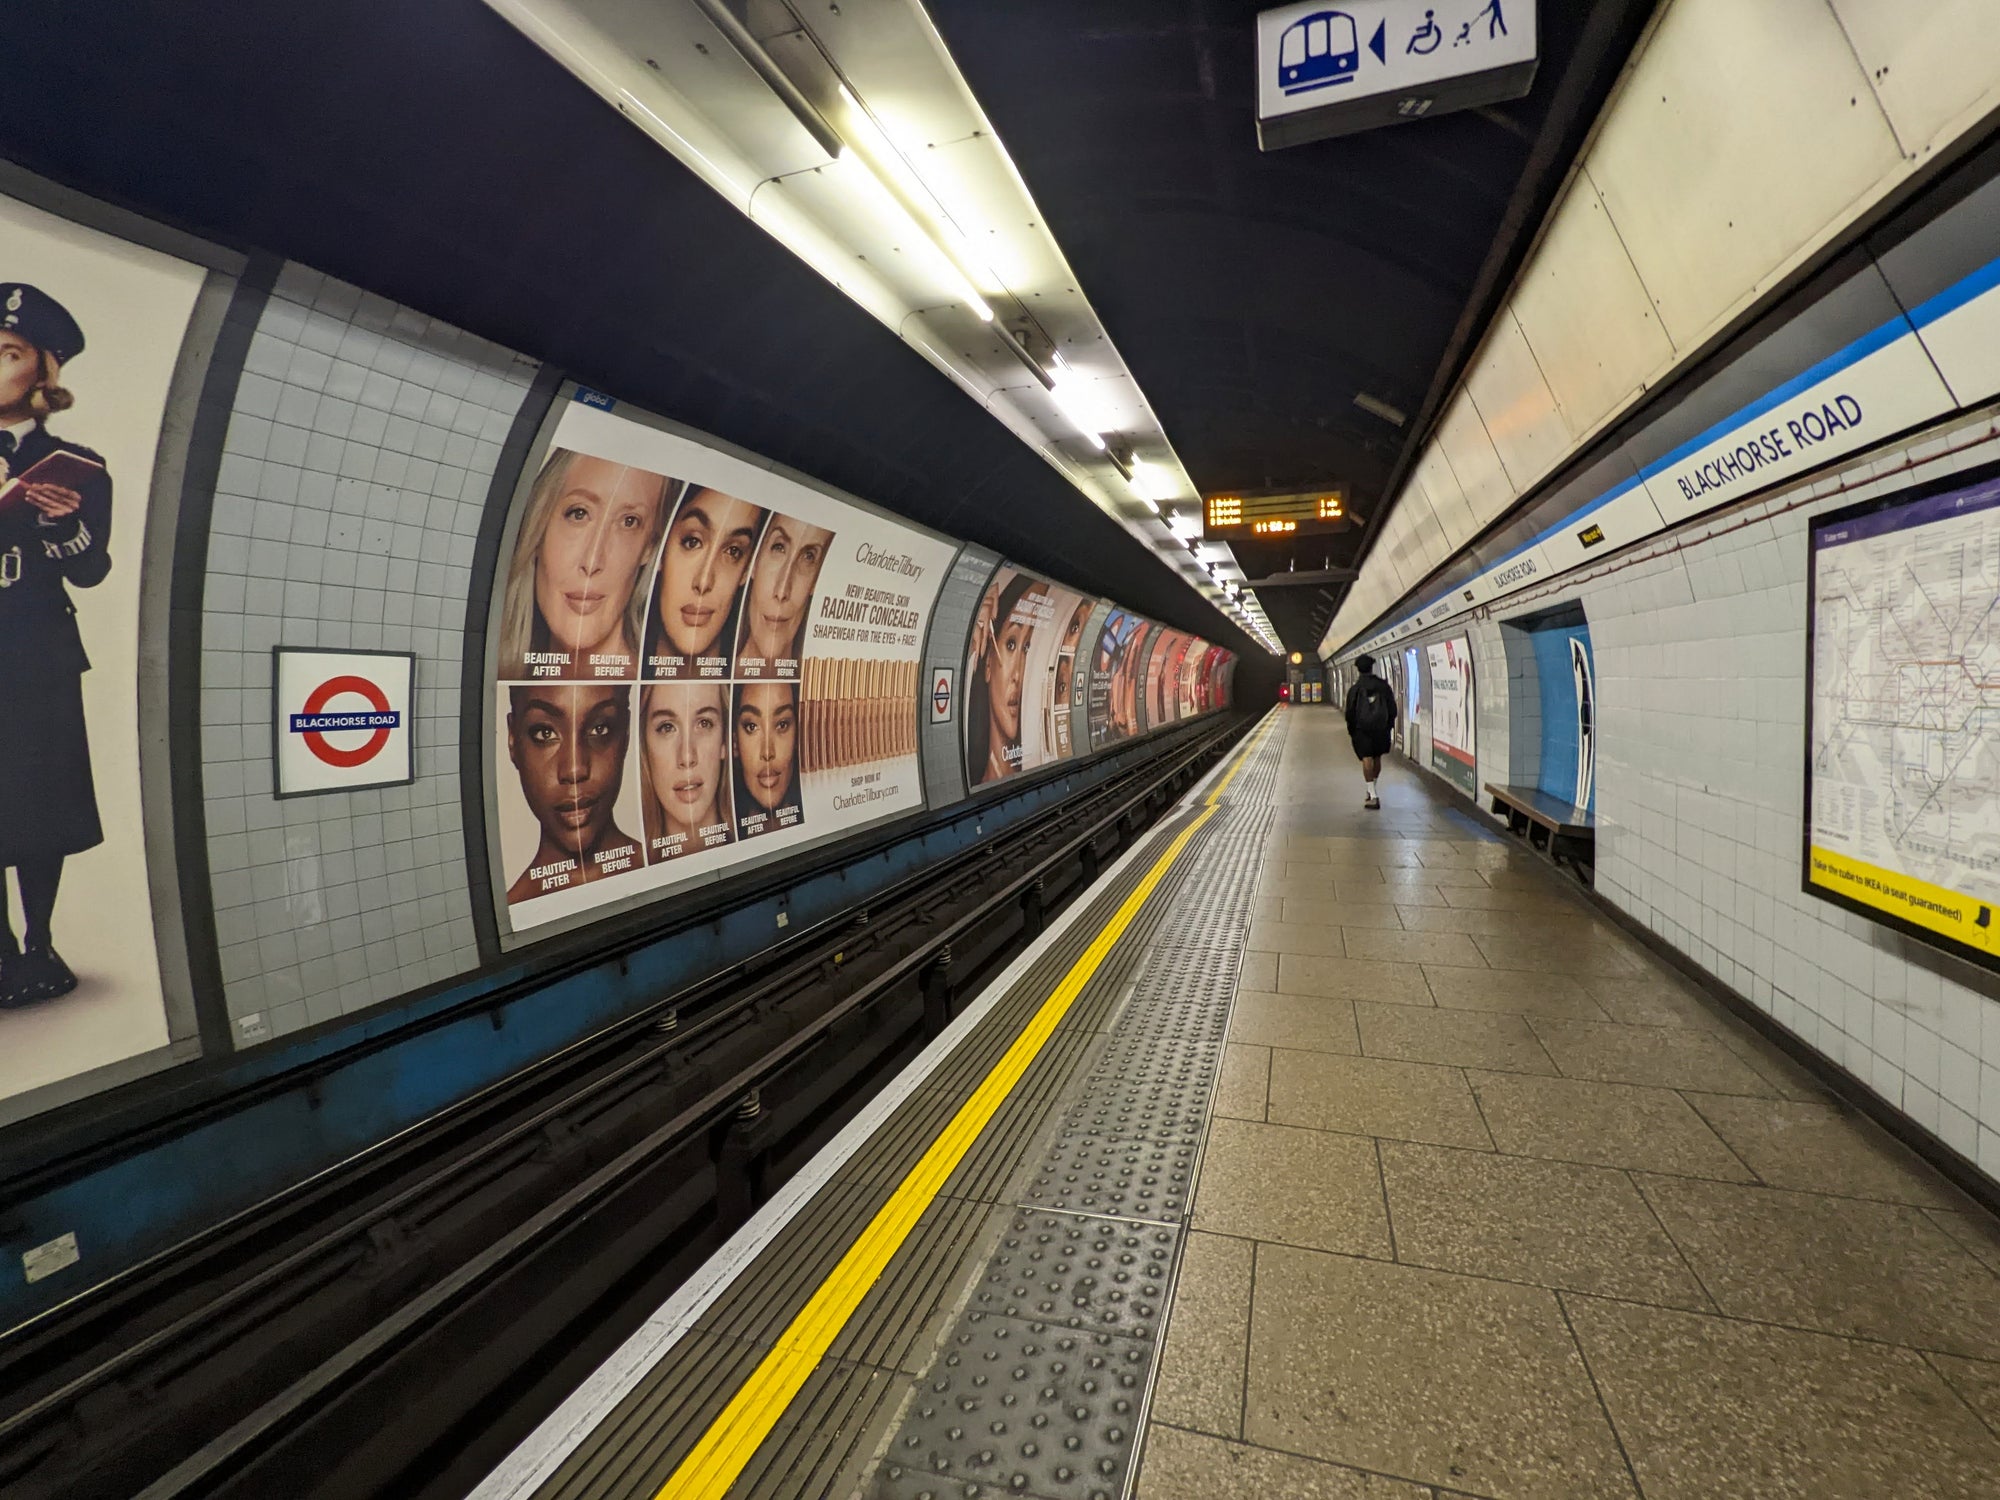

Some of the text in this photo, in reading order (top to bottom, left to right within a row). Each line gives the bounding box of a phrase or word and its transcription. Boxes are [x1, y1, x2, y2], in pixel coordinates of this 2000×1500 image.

[1677, 394, 1862, 501] BLACKHORSE ROAD
[845, 583, 910, 608] NEW! BEAUTIFUL SKIN
[821, 596, 919, 630] RADIANT CONCEALER
[813, 624, 856, 641] SHAPEWEAR
[856, 628, 869, 643] FOR
[870, 630, 881, 643] THE
[882, 631, 896, 645] EYES
[524, 652, 571, 665] BEAUTIFUL
[589, 654, 631, 665] BEAUTIFUL
[649, 656, 684, 666] BEAUTIFUL
[696, 657, 728, 666] BEAUTIFUL
[739, 658, 766, 667] BEAUTIFUL
[774, 659, 798, 668] BEAUTIFUL
[533, 666, 561, 676] AFTER
[594, 667, 625, 676] BEFORE
[655, 667, 677, 676] AFTER
[700, 667, 723, 676] BEFORE
[744, 668, 760, 676] AFTER
[777, 668, 794, 677] BEFORE
[295, 716, 396, 728] BLACKHORSE ROAD
[775, 805, 800, 818] BEAUTIFUL
[741, 812, 768, 827] BEAUTIFUL
[780, 814, 798, 826] BEFORE
[699, 822, 730, 837] BEAUTIFUL
[747, 823, 764, 835] AFTER
[652, 831, 688, 849] BEAUTIFUL
[704, 832, 727, 846] BEFORE
[594, 844, 635, 864] BEAUTIFUL
[661, 844, 683, 858] AFTER
[530, 859, 577, 880] BEAUTIFUL
[601, 857, 631, 874] BEFORE
[542, 873, 570, 891] AFTER
[1813, 858, 1962, 923] Take the tube to IKEA (a seat guaranteed)
